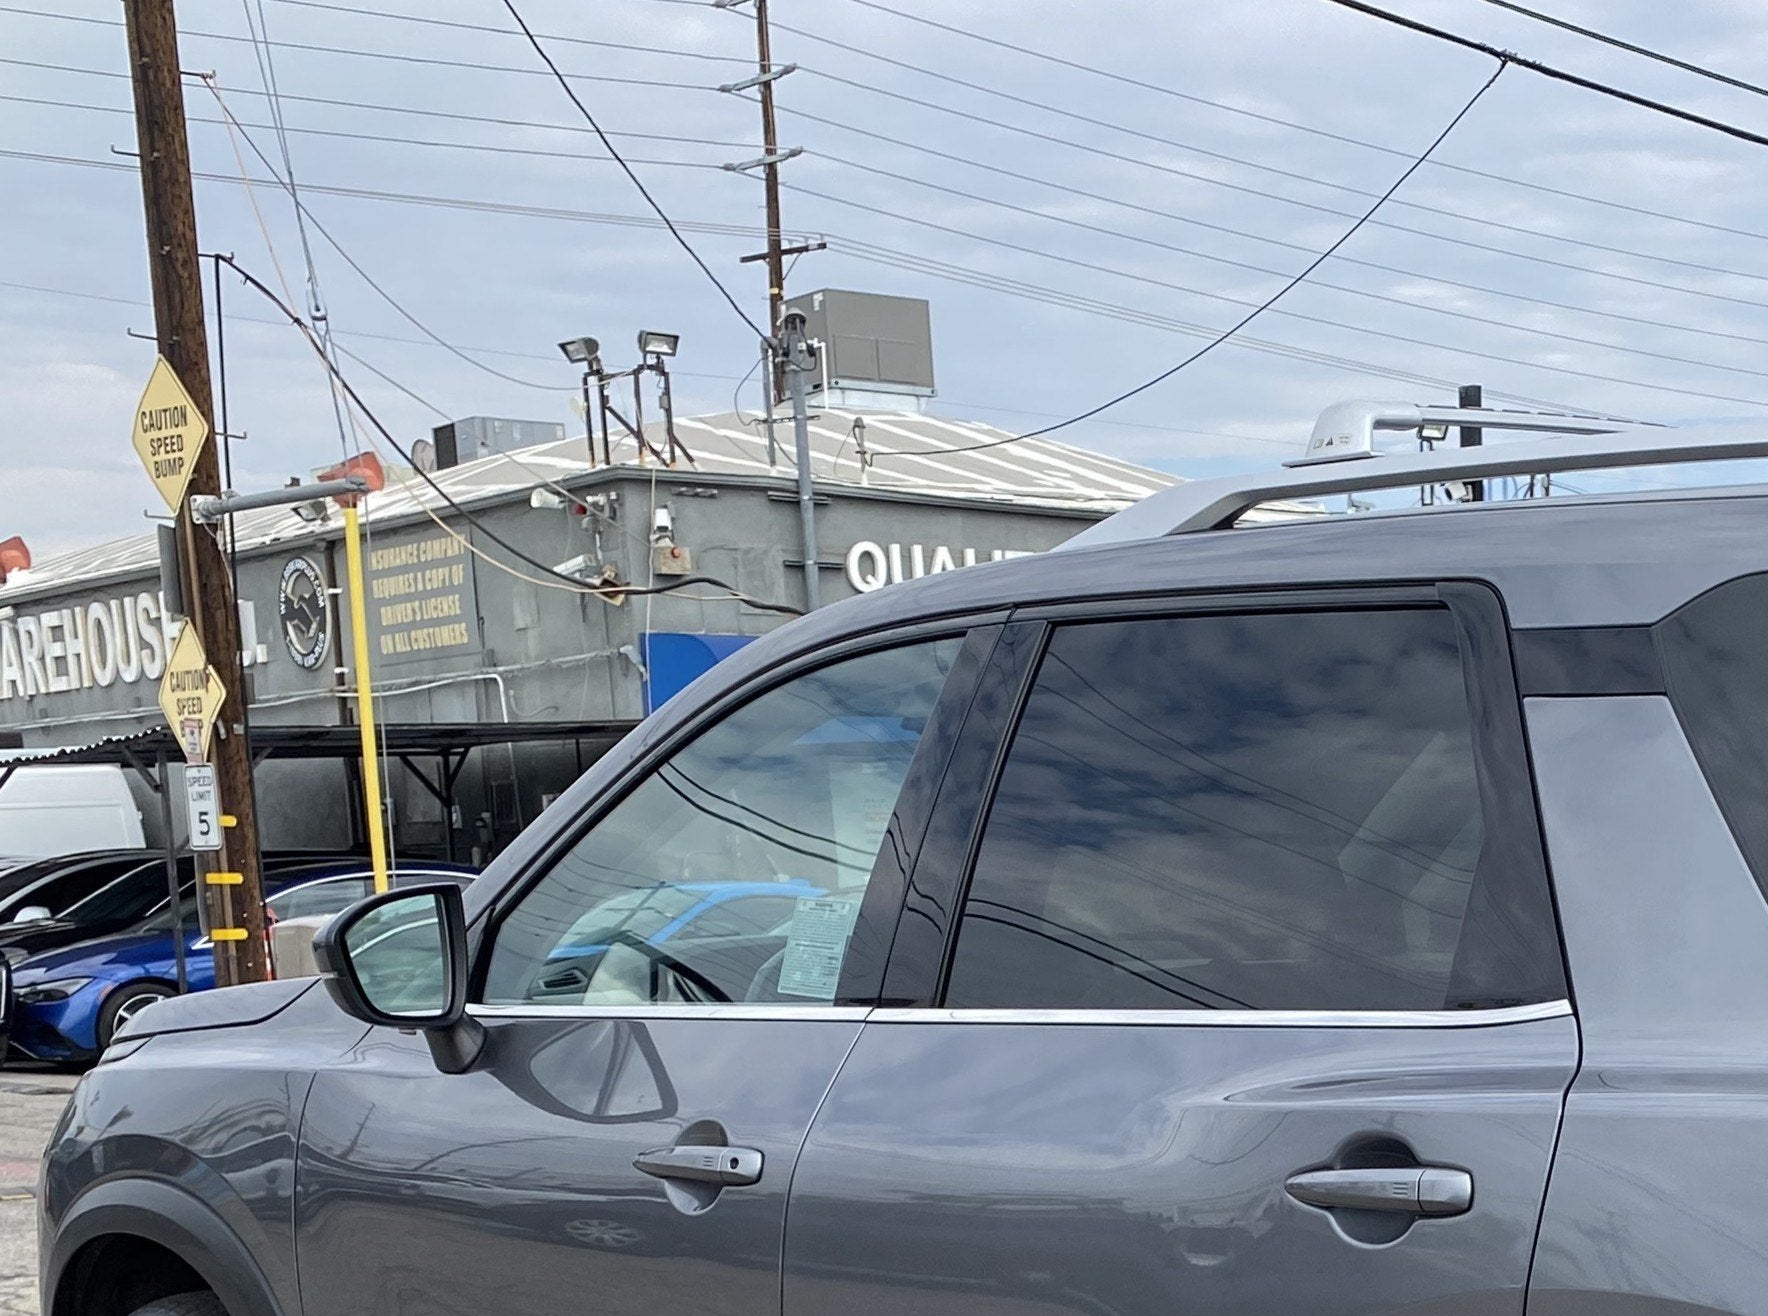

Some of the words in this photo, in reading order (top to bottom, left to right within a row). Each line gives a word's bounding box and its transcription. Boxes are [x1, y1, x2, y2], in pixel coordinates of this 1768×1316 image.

[140, 404, 188, 434] CAUTION
[150, 434, 184, 457] SPEED
[154, 456, 184, 479] BUMP
[847, 541, 1036, 592] QUA
[372, 572, 416, 599] REQUIRES
[416, 571, 424, 592] A
[425, 566, 450, 591] COPY
[451, 563, 464, 586] OF
[422, 594, 462, 620] LICENSE
[0, 590, 183, 699] AREHOUS
[380, 634, 394, 656] ON
[395, 631, 411, 653] ALL
[410, 622, 469, 651] CUSTOMERS
[170, 669, 207, 693] CAUTION
[176, 697, 203, 716] SPEED
[180, 719, 203, 738] BP
[187, 776, 213, 788] SPEED
[191, 790, 211, 802] LIMIT
[198, 811, 211, 836] 5
